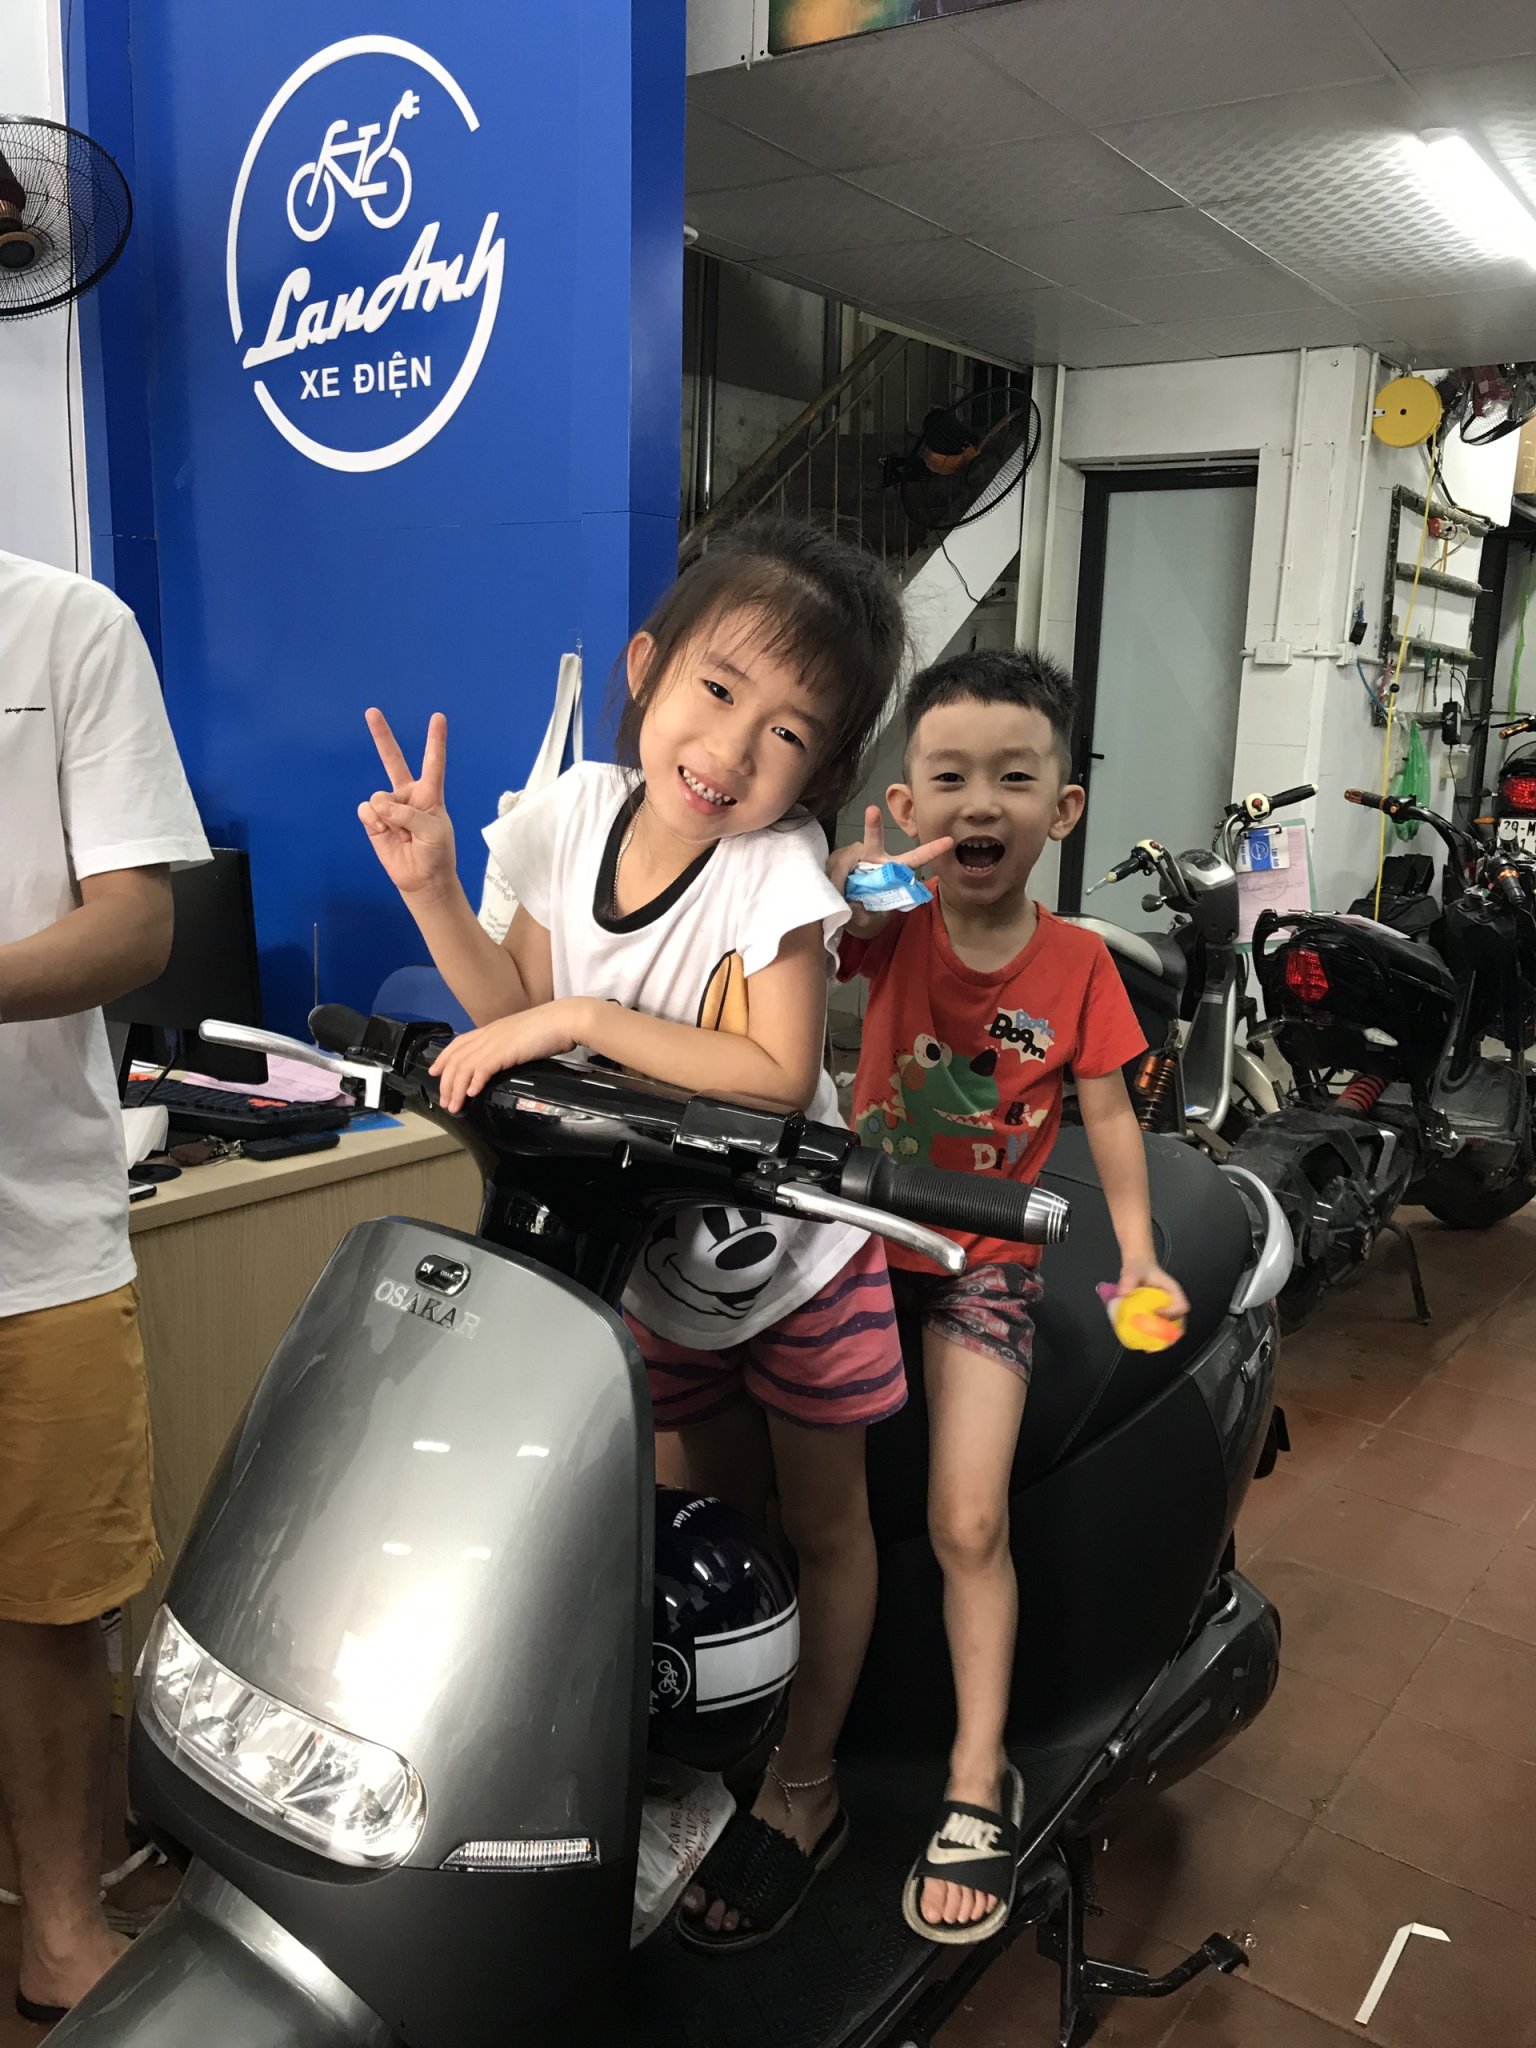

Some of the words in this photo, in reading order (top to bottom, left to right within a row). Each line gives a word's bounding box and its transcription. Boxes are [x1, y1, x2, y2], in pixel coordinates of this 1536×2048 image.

[300, 366, 340, 400] XE
[353, 351, 432, 399] ĐIỆN
[989, 1013, 1046, 1060] Boom
[374, 1280, 481, 1340] OSAKAR
[940, 1811, 1003, 1853] NIKE
